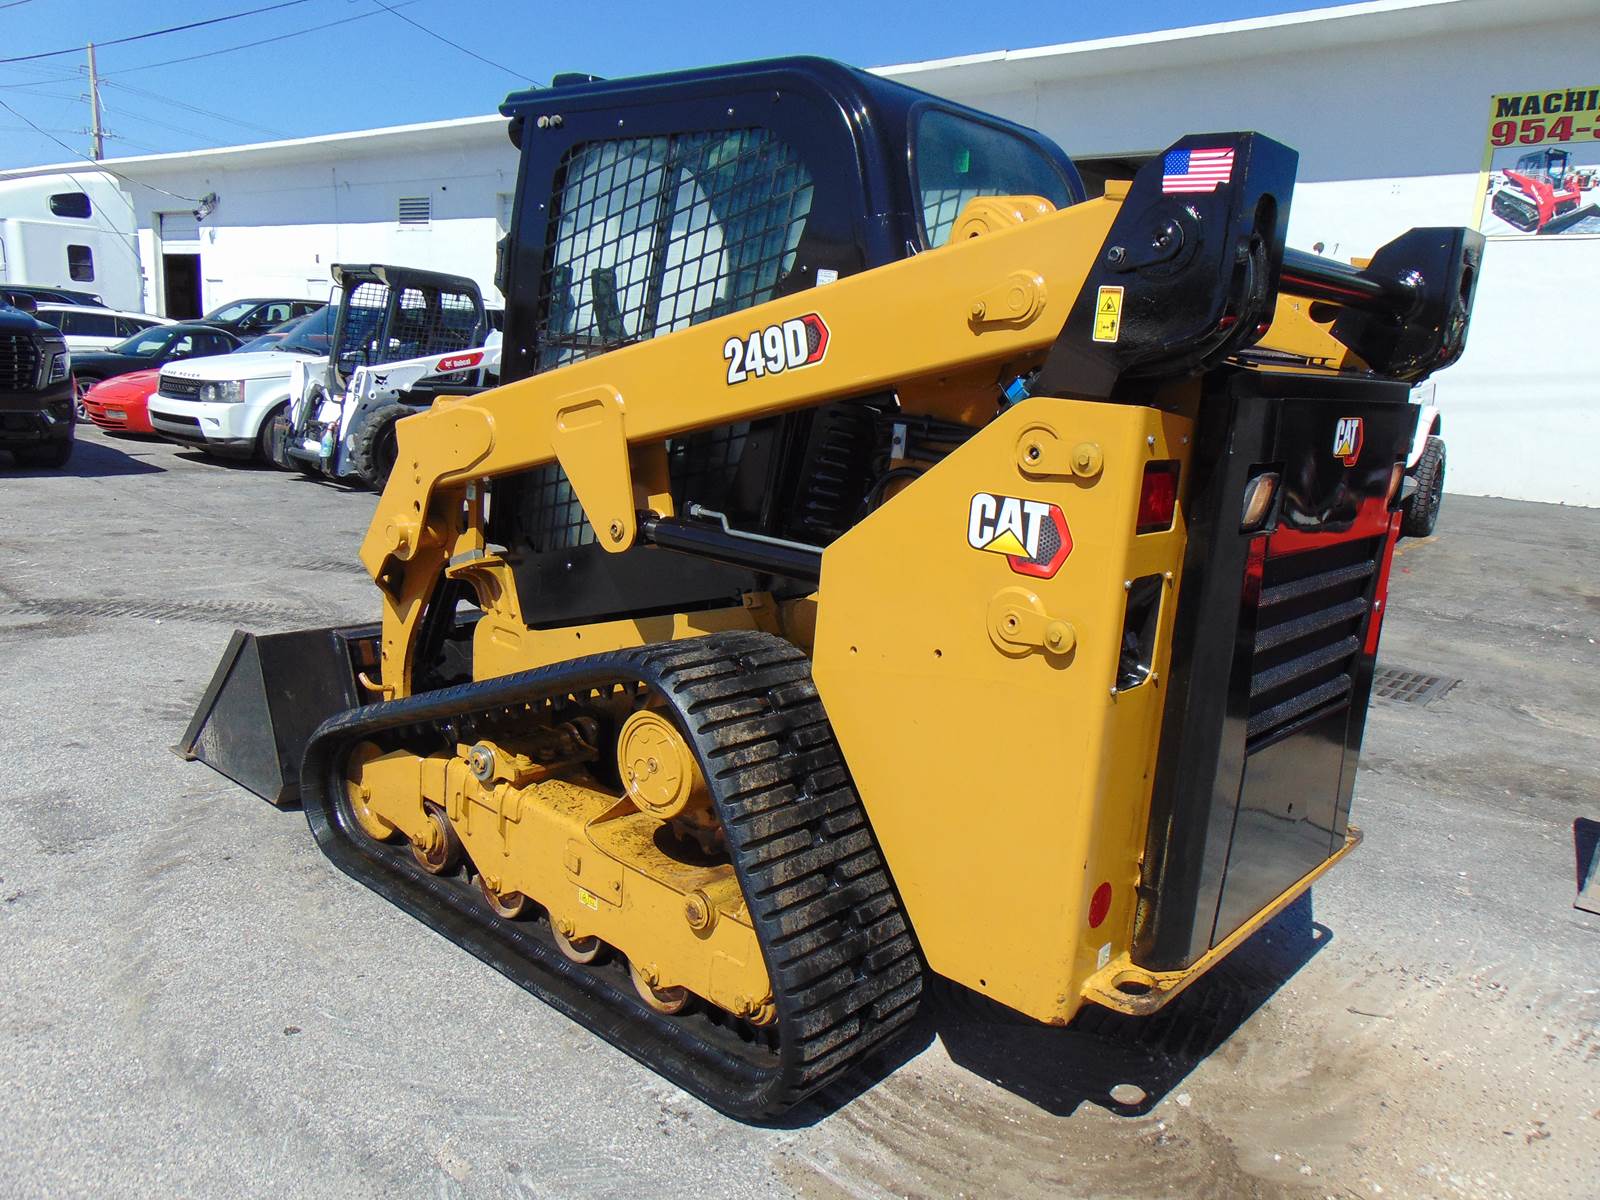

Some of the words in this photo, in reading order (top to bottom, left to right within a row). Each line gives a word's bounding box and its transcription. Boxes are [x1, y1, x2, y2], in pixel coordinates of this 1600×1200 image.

[1496, 90, 1600, 117] MACHI
[724, 319, 809, 384] 249D
[1333, 419, 1359, 455] CAT
[968, 493, 1050, 559] CAT
